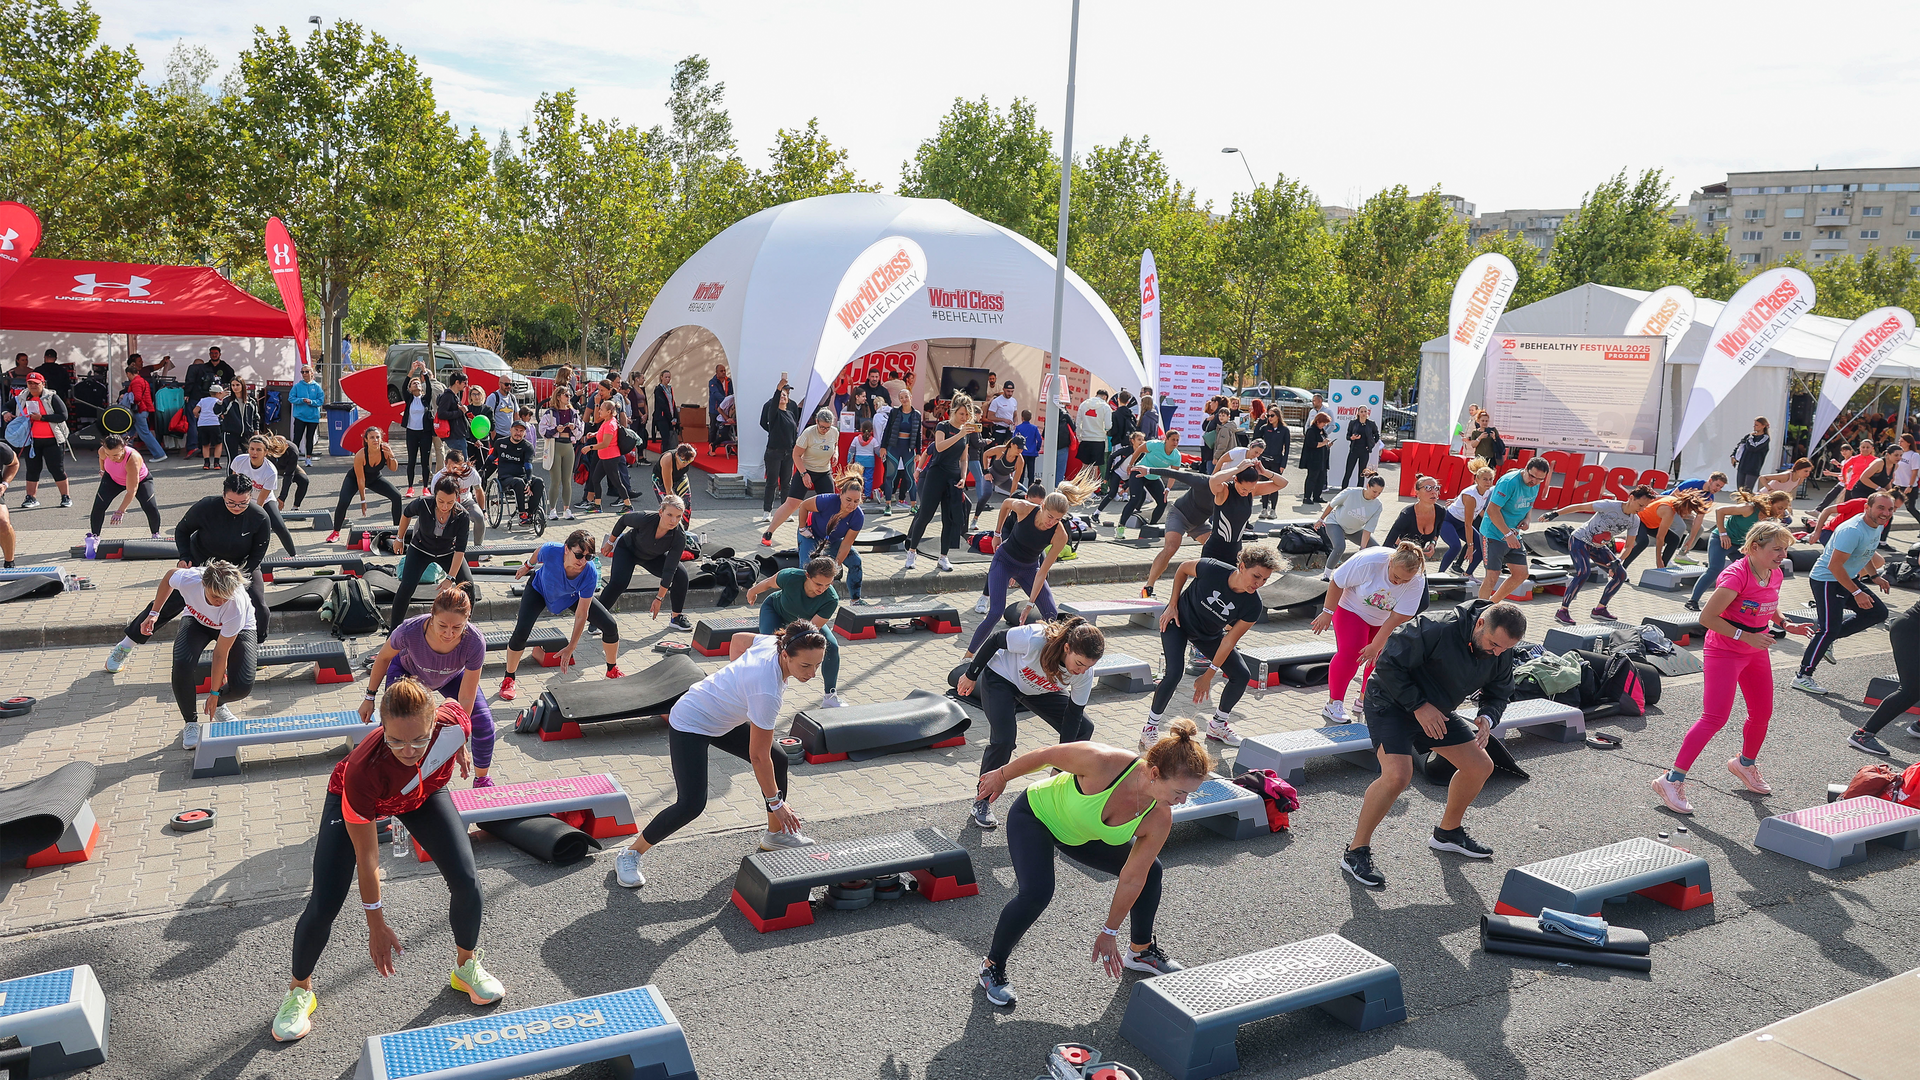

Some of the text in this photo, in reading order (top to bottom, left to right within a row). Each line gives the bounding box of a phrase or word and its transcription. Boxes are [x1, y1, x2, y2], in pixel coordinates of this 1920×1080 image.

[105, 297, 164, 305] ARMOUR
[835, 248, 913, 332] World Class
[852, 270, 920, 340] #BEHEALTHY
[927, 287, 1005, 312] World Class
[1453, 263, 1503, 347] World Class
[932, 310, 1004, 324] #BEHEALTHY
[1473, 274, 1513, 350] #BEHEALTHY
[1644, 296, 1681, 336] Class
[1714, 307, 1765, 360] World
[1752, 278, 1800, 322] Class
[1737, 295, 1808, 366] #BEHEALTHY
[1502, 338, 1516, 350] 25
[1520, 342, 1651, 353] #BEHEALTHY FESTIVAL 2025
[1834, 315, 1903, 379] World Class
[1852, 329, 1909, 383] #BEHEALTHY
[1021, 666, 1047, 689] World
[245, 716, 341, 730] Reebok
[473, 783, 578, 803] Reebok
[1566, 850, 1654, 874] Reebok
[1208, 953, 1333, 991] Reebok
[444, 1009, 607, 1051] Reebok
